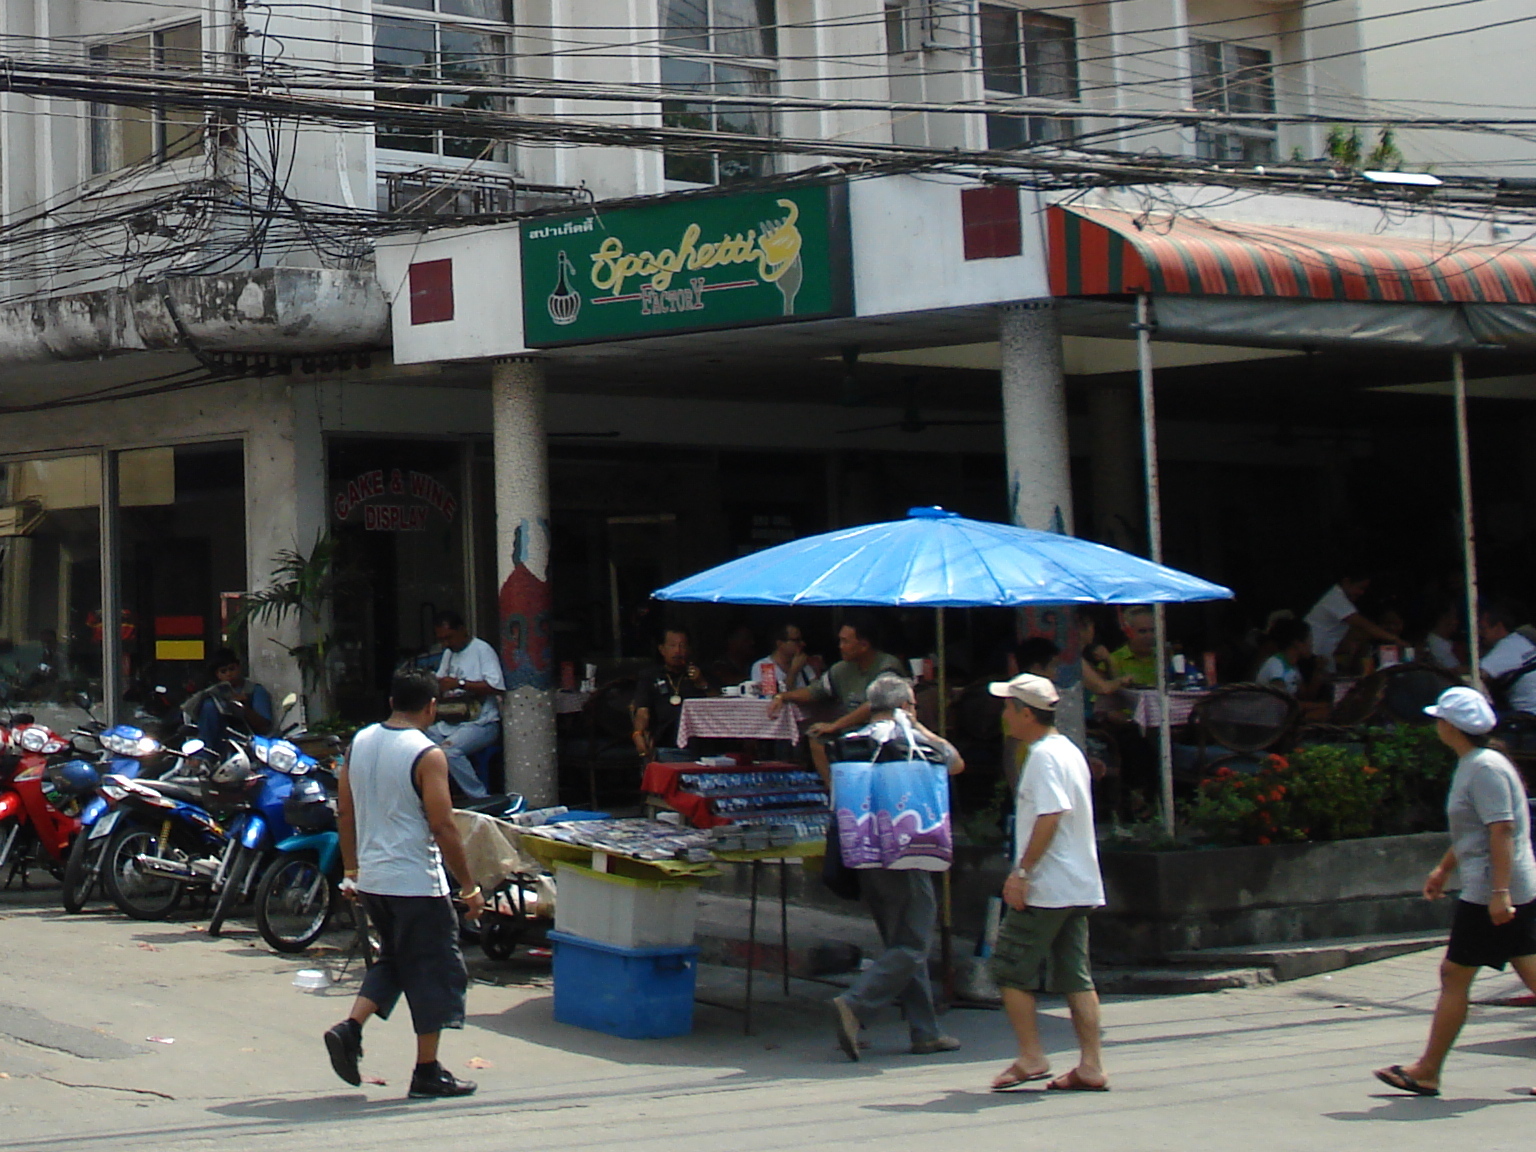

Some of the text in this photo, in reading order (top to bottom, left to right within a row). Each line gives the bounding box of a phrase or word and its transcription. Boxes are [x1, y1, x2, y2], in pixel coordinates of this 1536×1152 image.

[590, 223, 761, 296] Spaghetti
[640, 277, 705, 315] FACTORY
[335, 468, 458, 523] CAKE & WINE
[365, 504, 428, 531] DISPLAY
